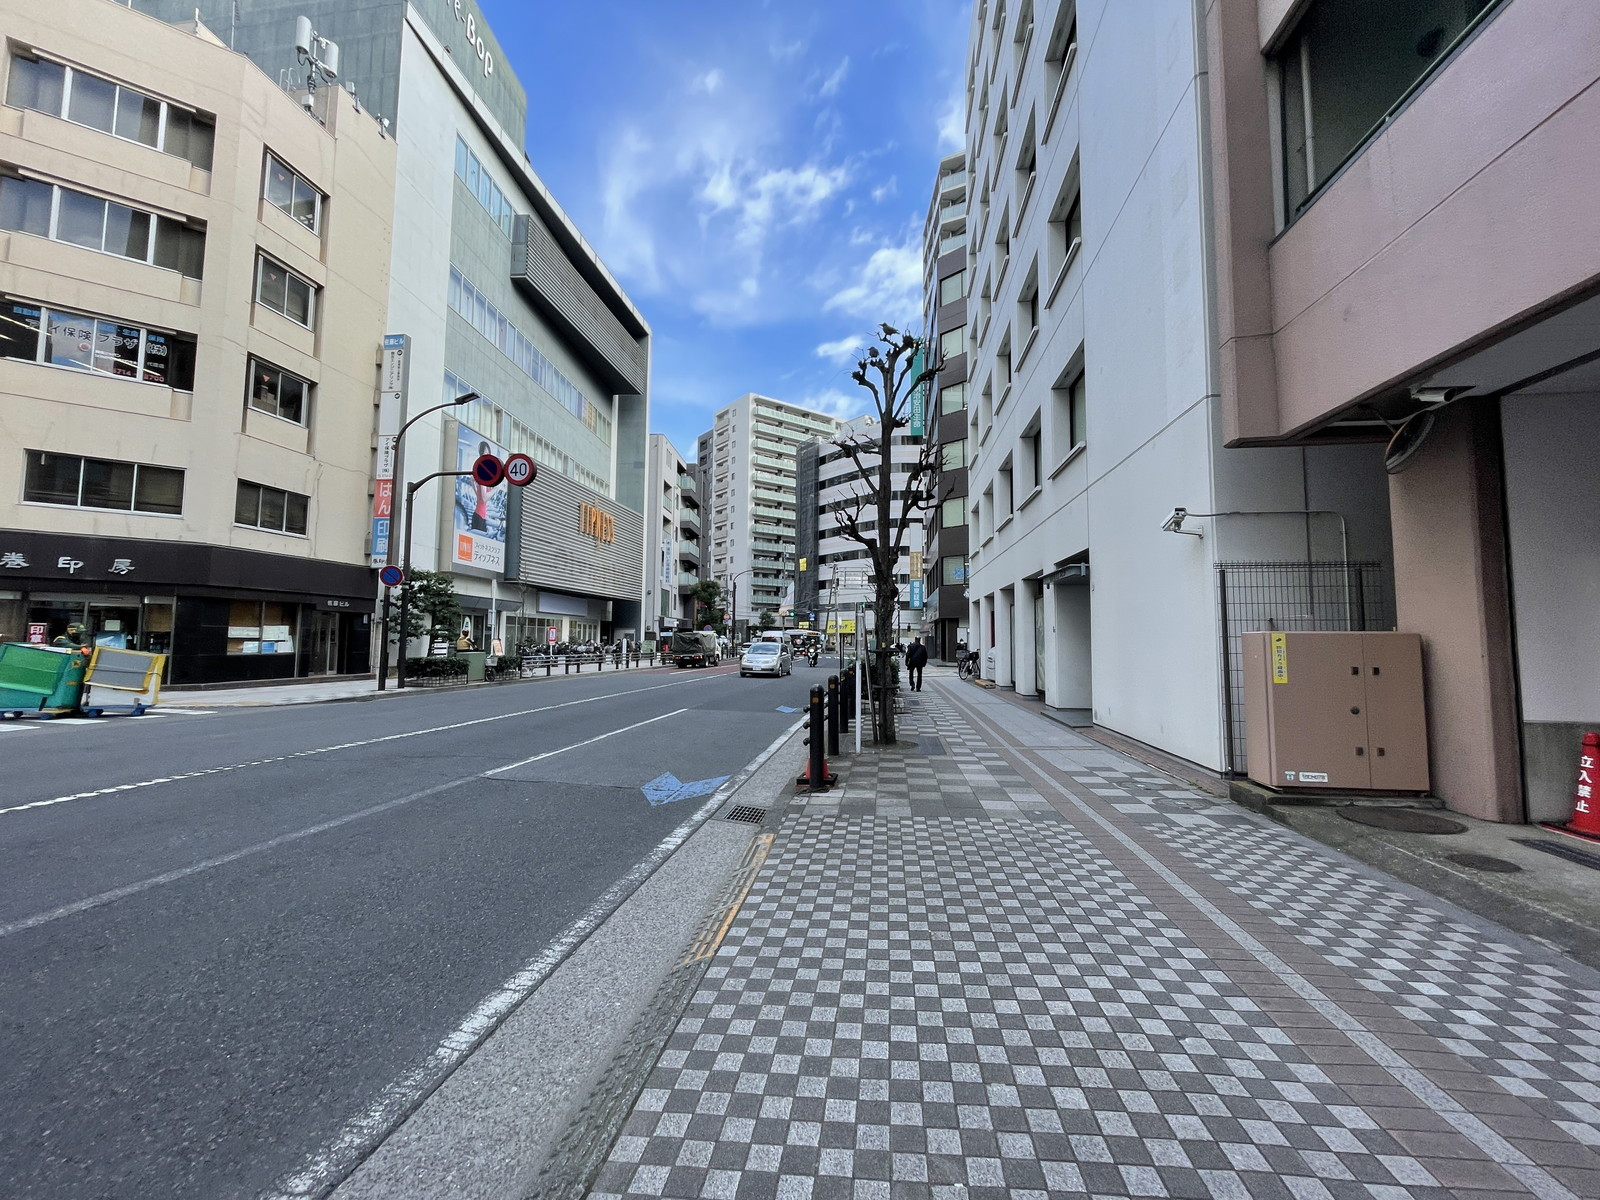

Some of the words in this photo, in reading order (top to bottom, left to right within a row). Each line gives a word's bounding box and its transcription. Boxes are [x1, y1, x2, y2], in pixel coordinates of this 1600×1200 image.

[446, 0, 494, 78] e-Bop
[509, 462, 528, 477] 40
[1575, 755, 1595, 814] 立入禁止
